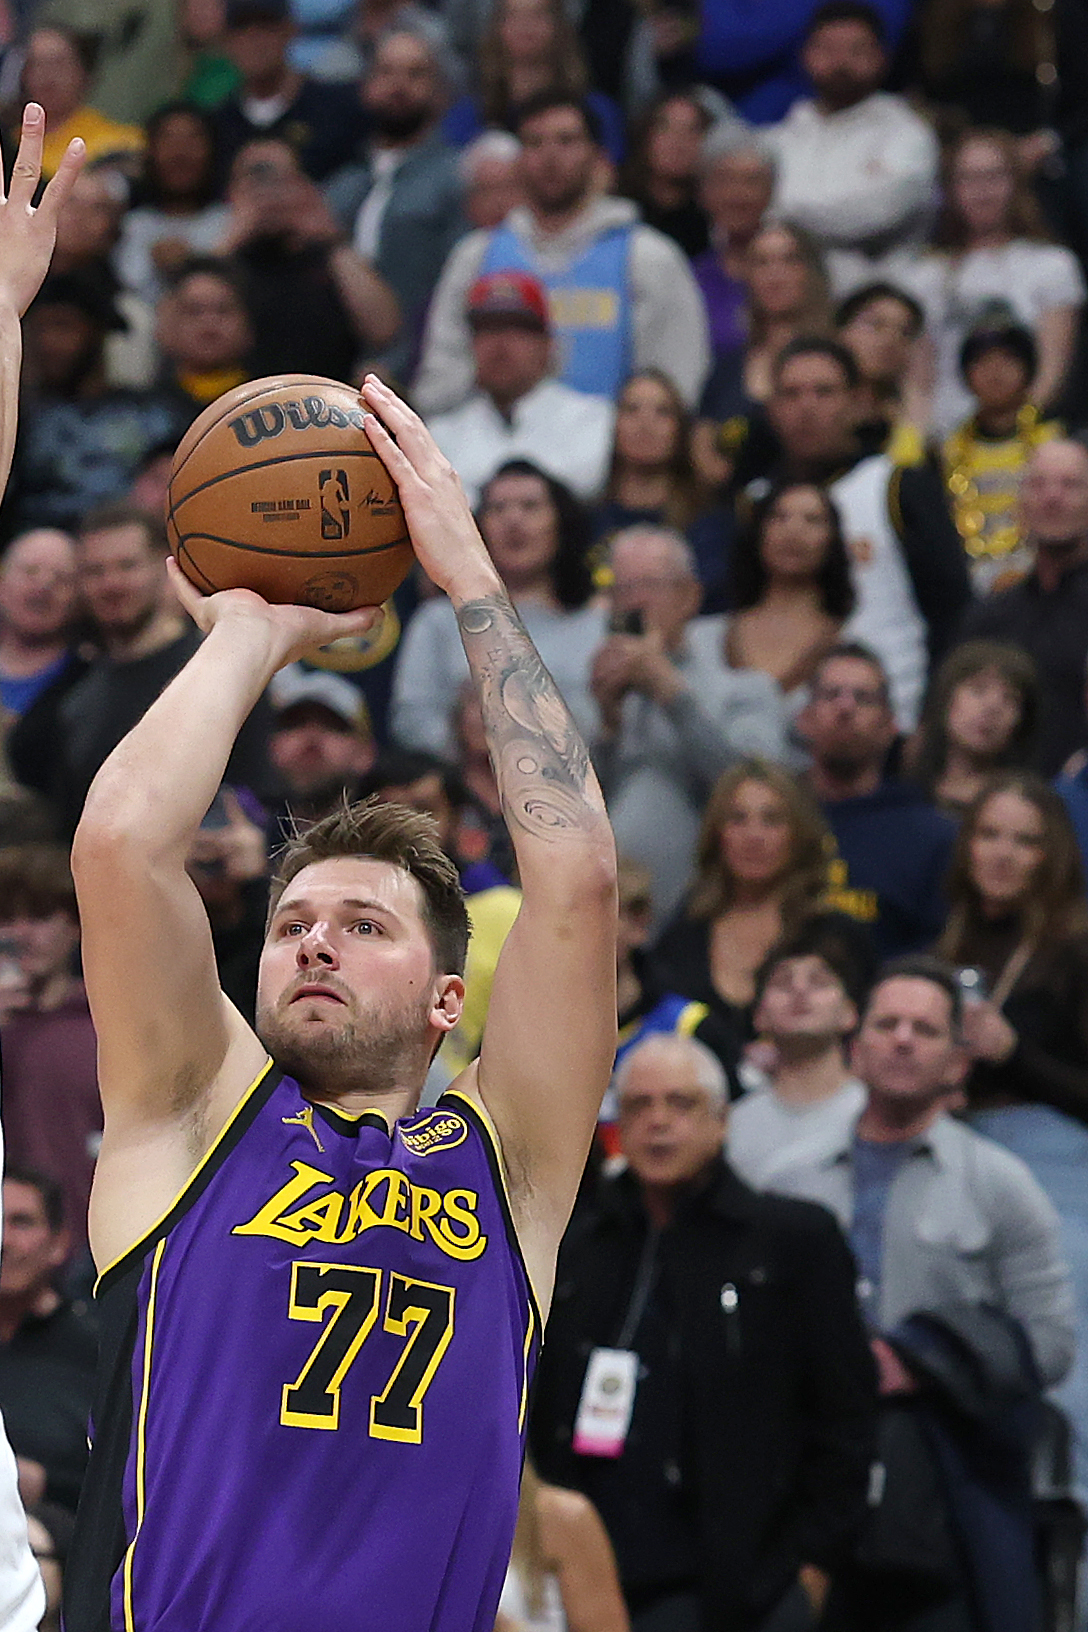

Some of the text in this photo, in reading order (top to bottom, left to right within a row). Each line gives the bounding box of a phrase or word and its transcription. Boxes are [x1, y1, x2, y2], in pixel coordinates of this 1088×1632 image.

[228, 396, 367, 448] Wilso
[230, 1160, 487, 1261] LAKERS
[280, 1261, 456, 1444] 77
